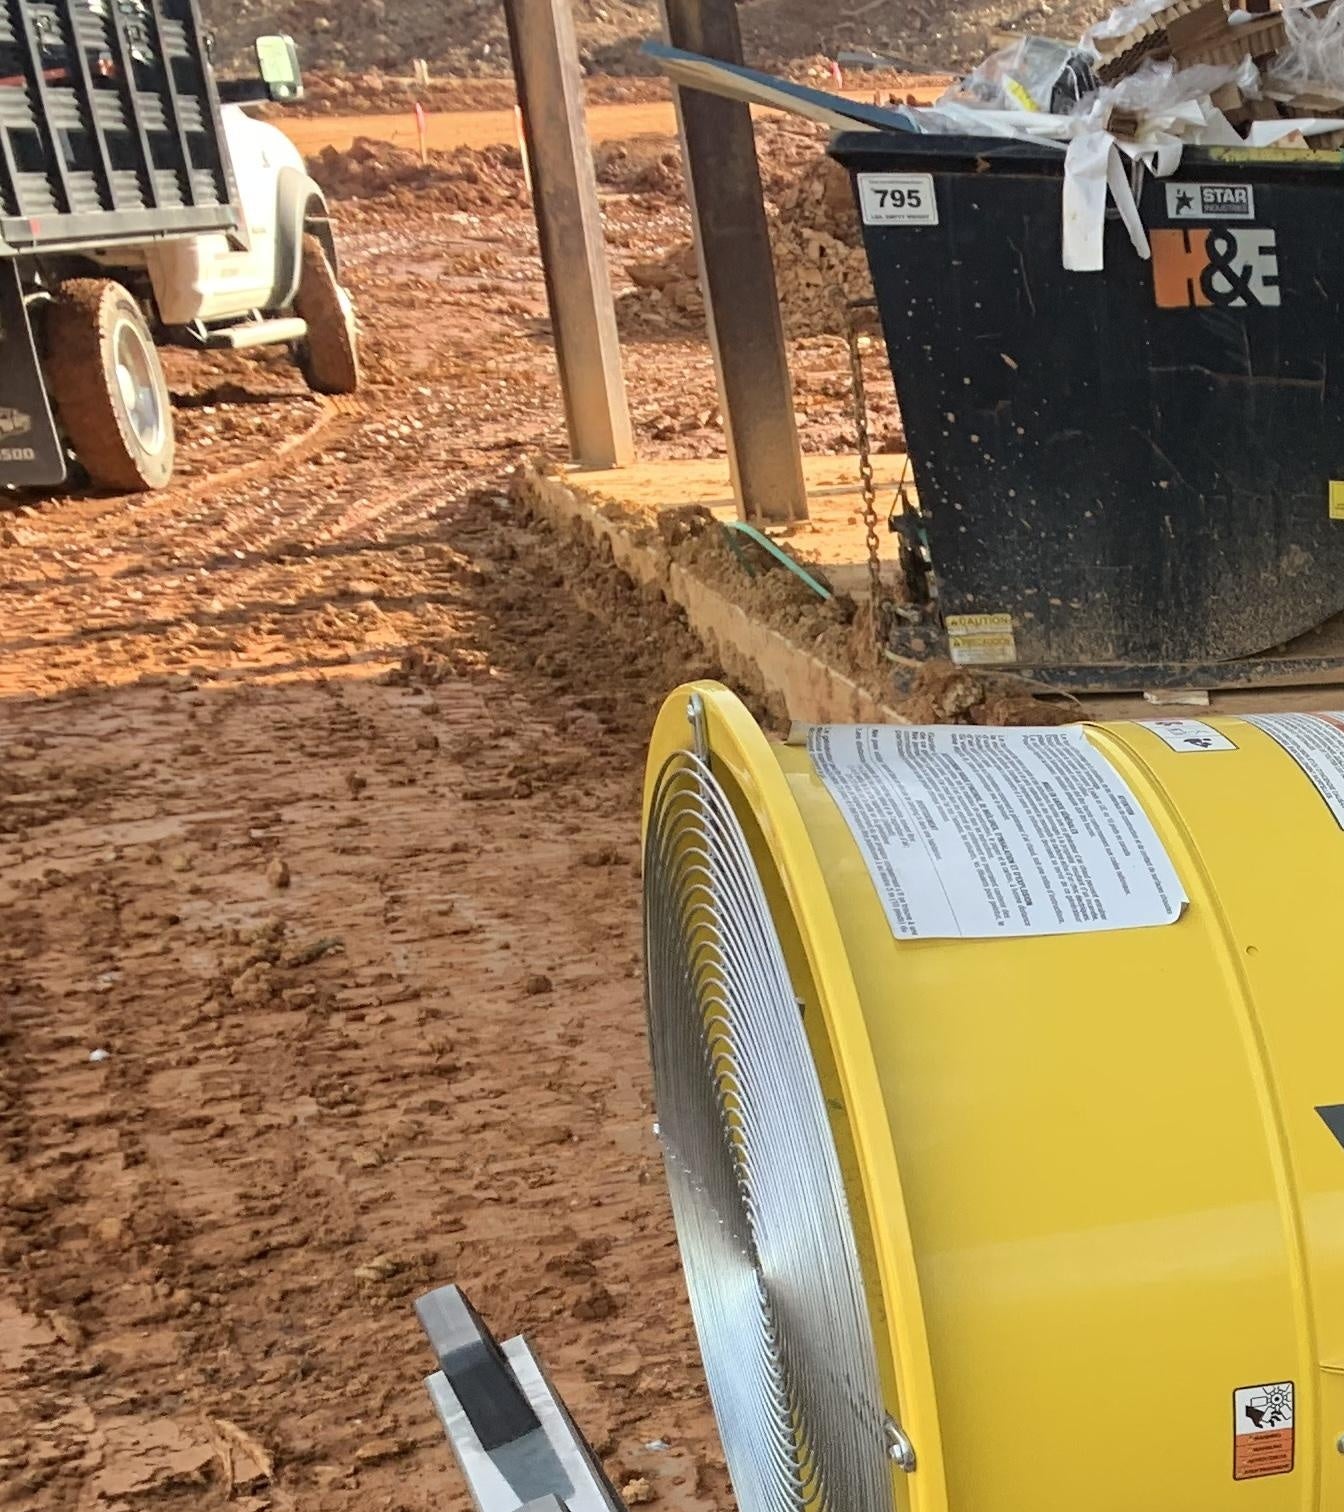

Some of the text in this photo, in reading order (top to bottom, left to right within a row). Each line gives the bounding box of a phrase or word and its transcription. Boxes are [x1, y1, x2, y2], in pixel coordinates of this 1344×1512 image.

[873, 189, 922, 208] 795
[1202, 188, 1247, 203] STAR
[1149, 227, 1281, 308] H&E
[0, 447, 35, 461] 500
